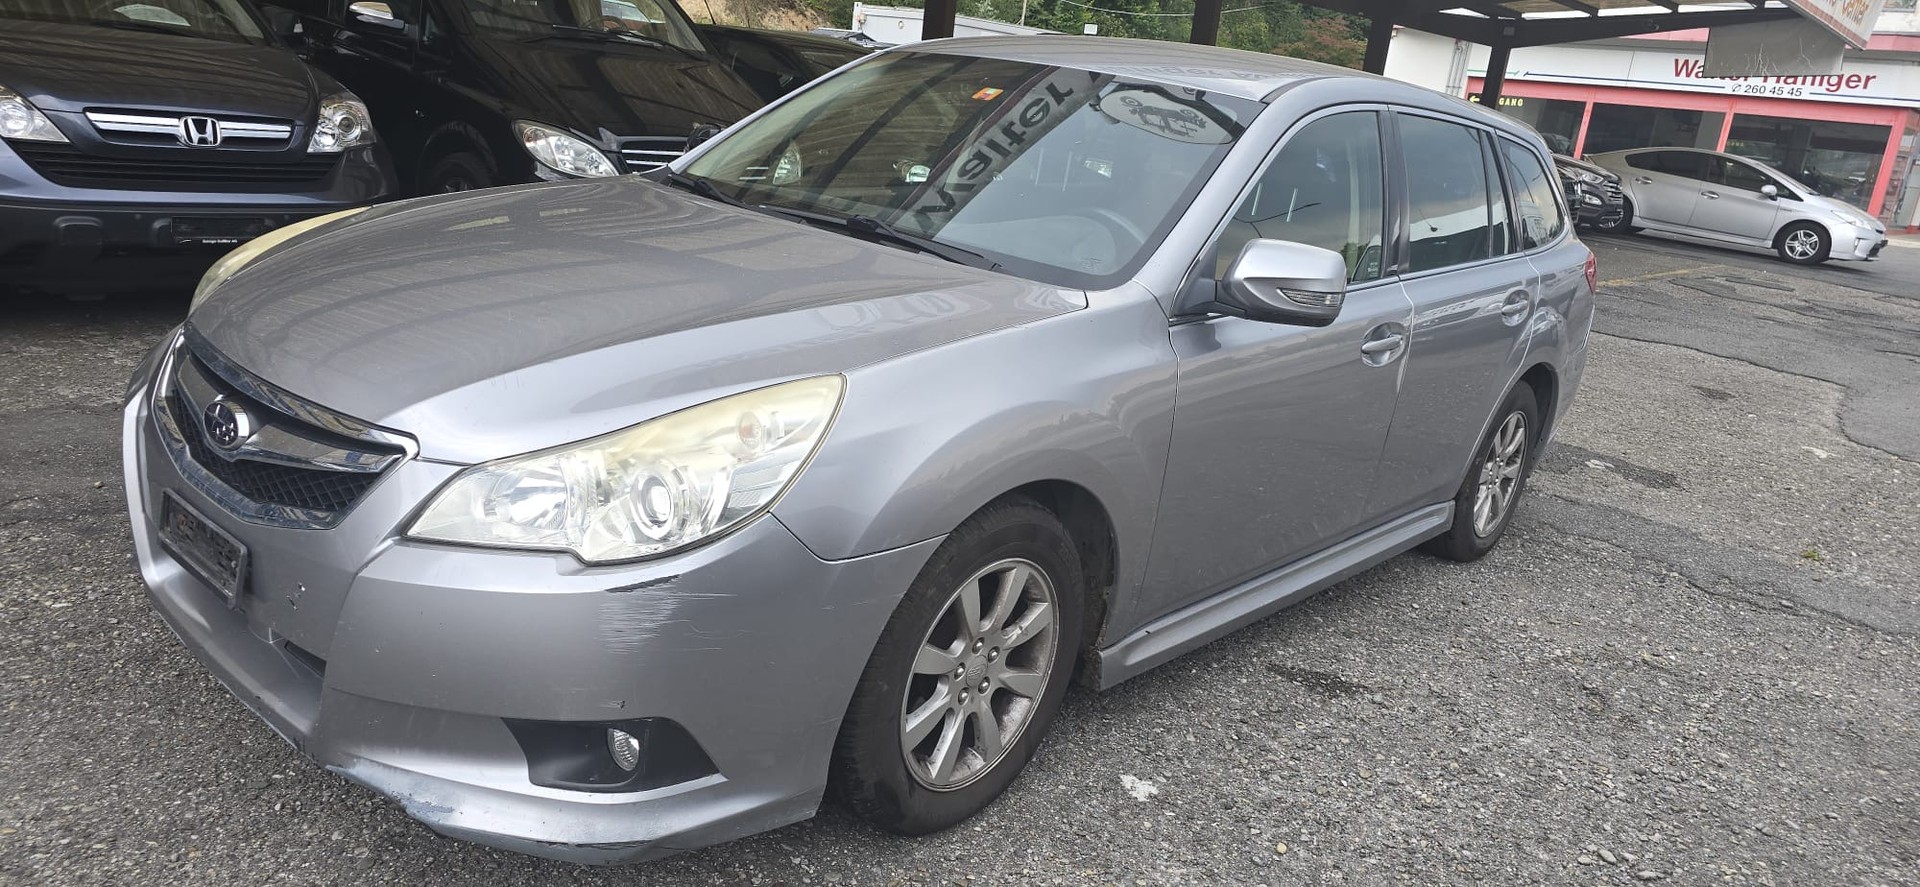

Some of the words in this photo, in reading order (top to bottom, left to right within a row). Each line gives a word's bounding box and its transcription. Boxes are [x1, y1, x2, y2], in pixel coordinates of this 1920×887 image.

[1744, 84, 1766, 94] 260
[1769, 86, 1784, 96] 45
[1787, 87, 1803, 97] 45
